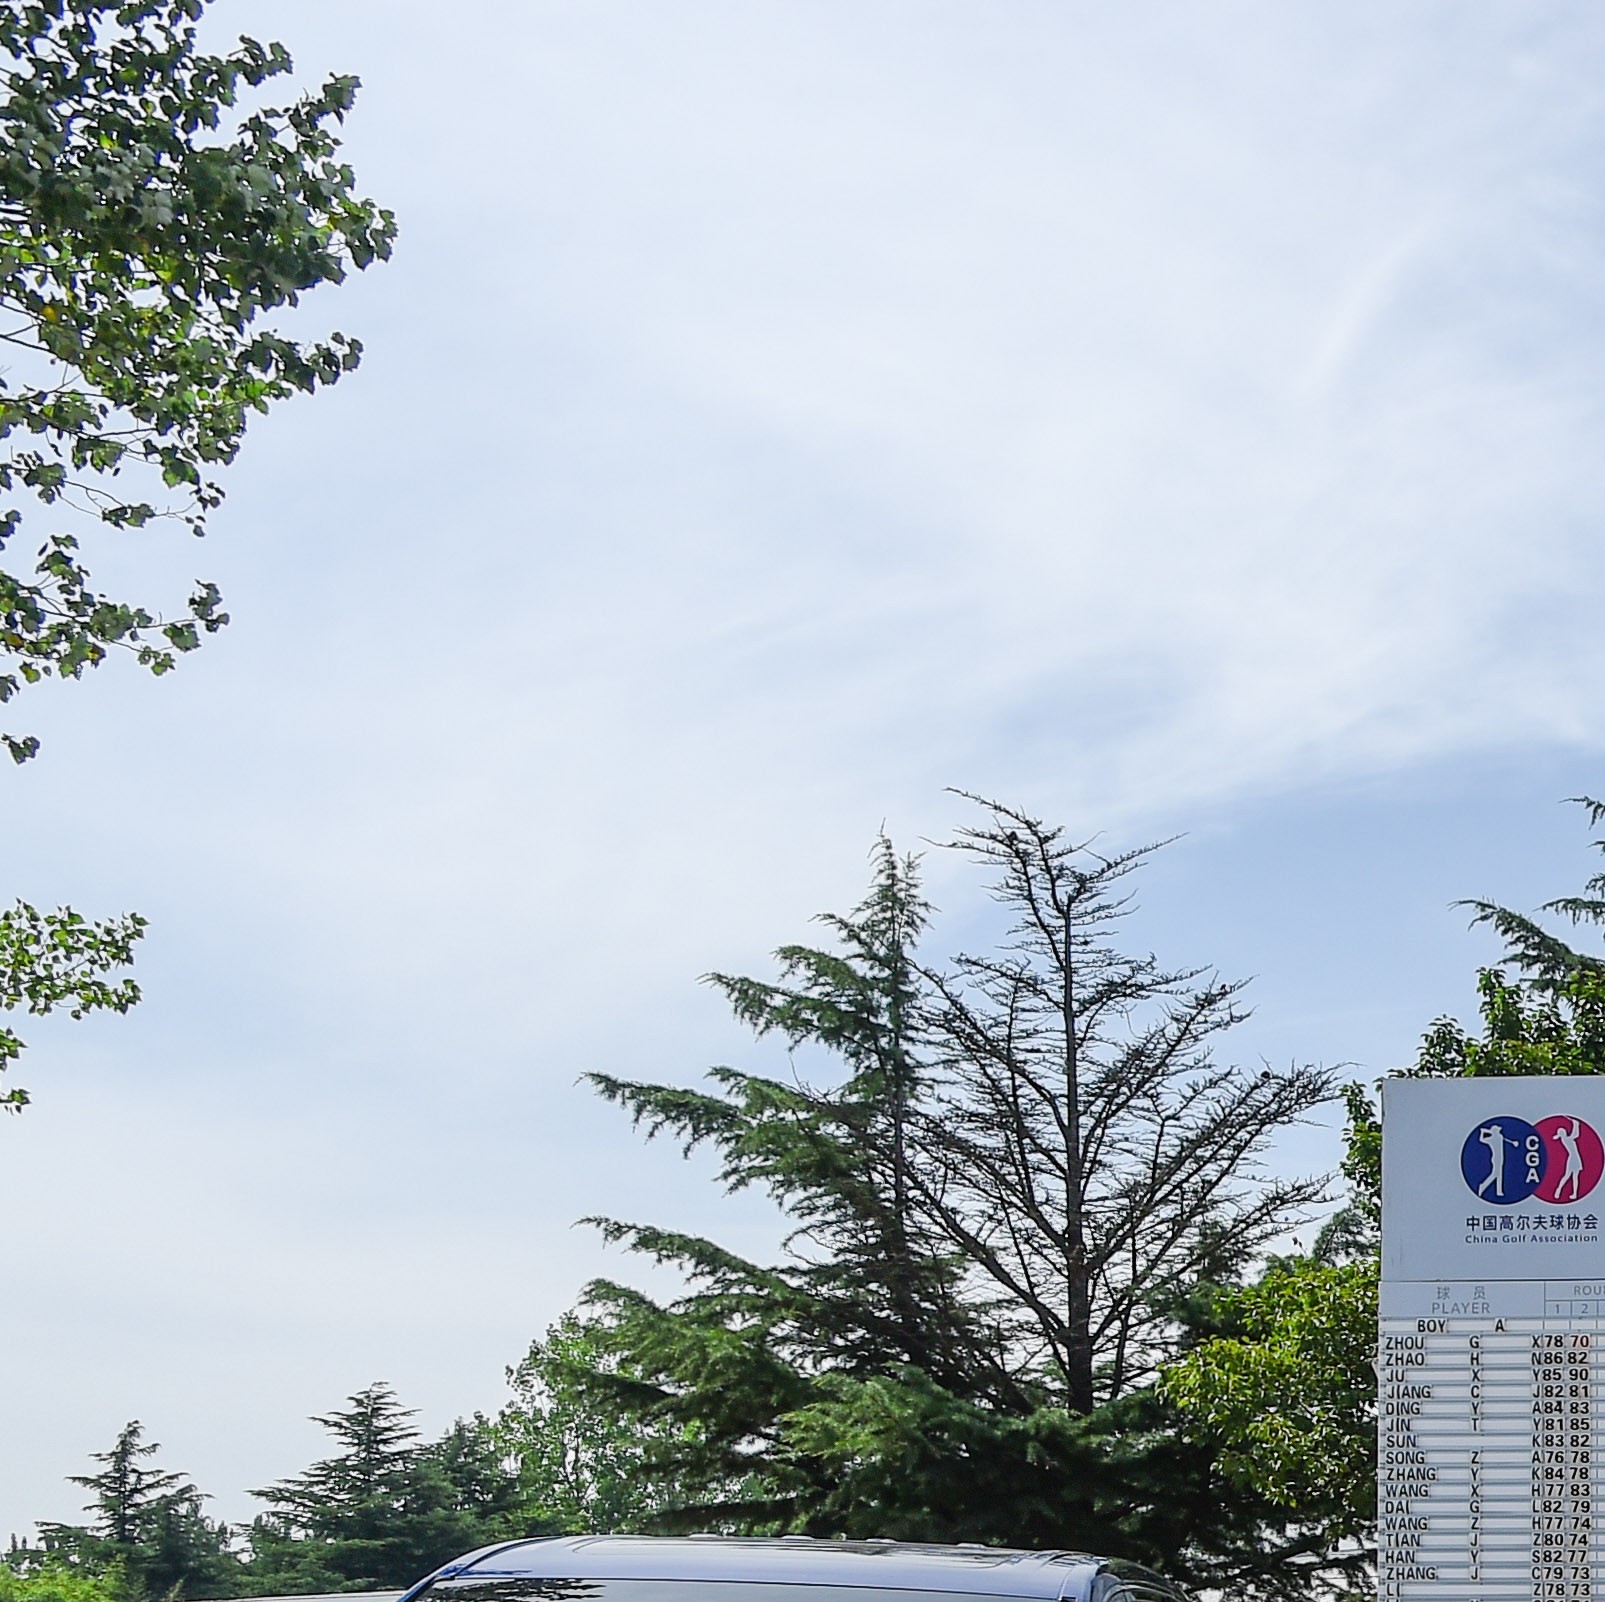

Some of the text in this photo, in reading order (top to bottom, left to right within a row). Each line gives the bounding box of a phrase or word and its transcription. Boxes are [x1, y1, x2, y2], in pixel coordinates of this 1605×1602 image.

[1525, 1135, 1540, 1184] CGA
[1466, 1214, 1598, 1231] 中国高尔夫球协会
[1465, 1234, 1598, 1244] China Golf Association
[1431, 1303, 1490, 1315] PLAYER
[1581, 1304, 1589, 1314] 2
[1417, 1319, 1505, 1333] BOY A
[1385, 1336, 1590, 1349] ZHOU G X 78 70
